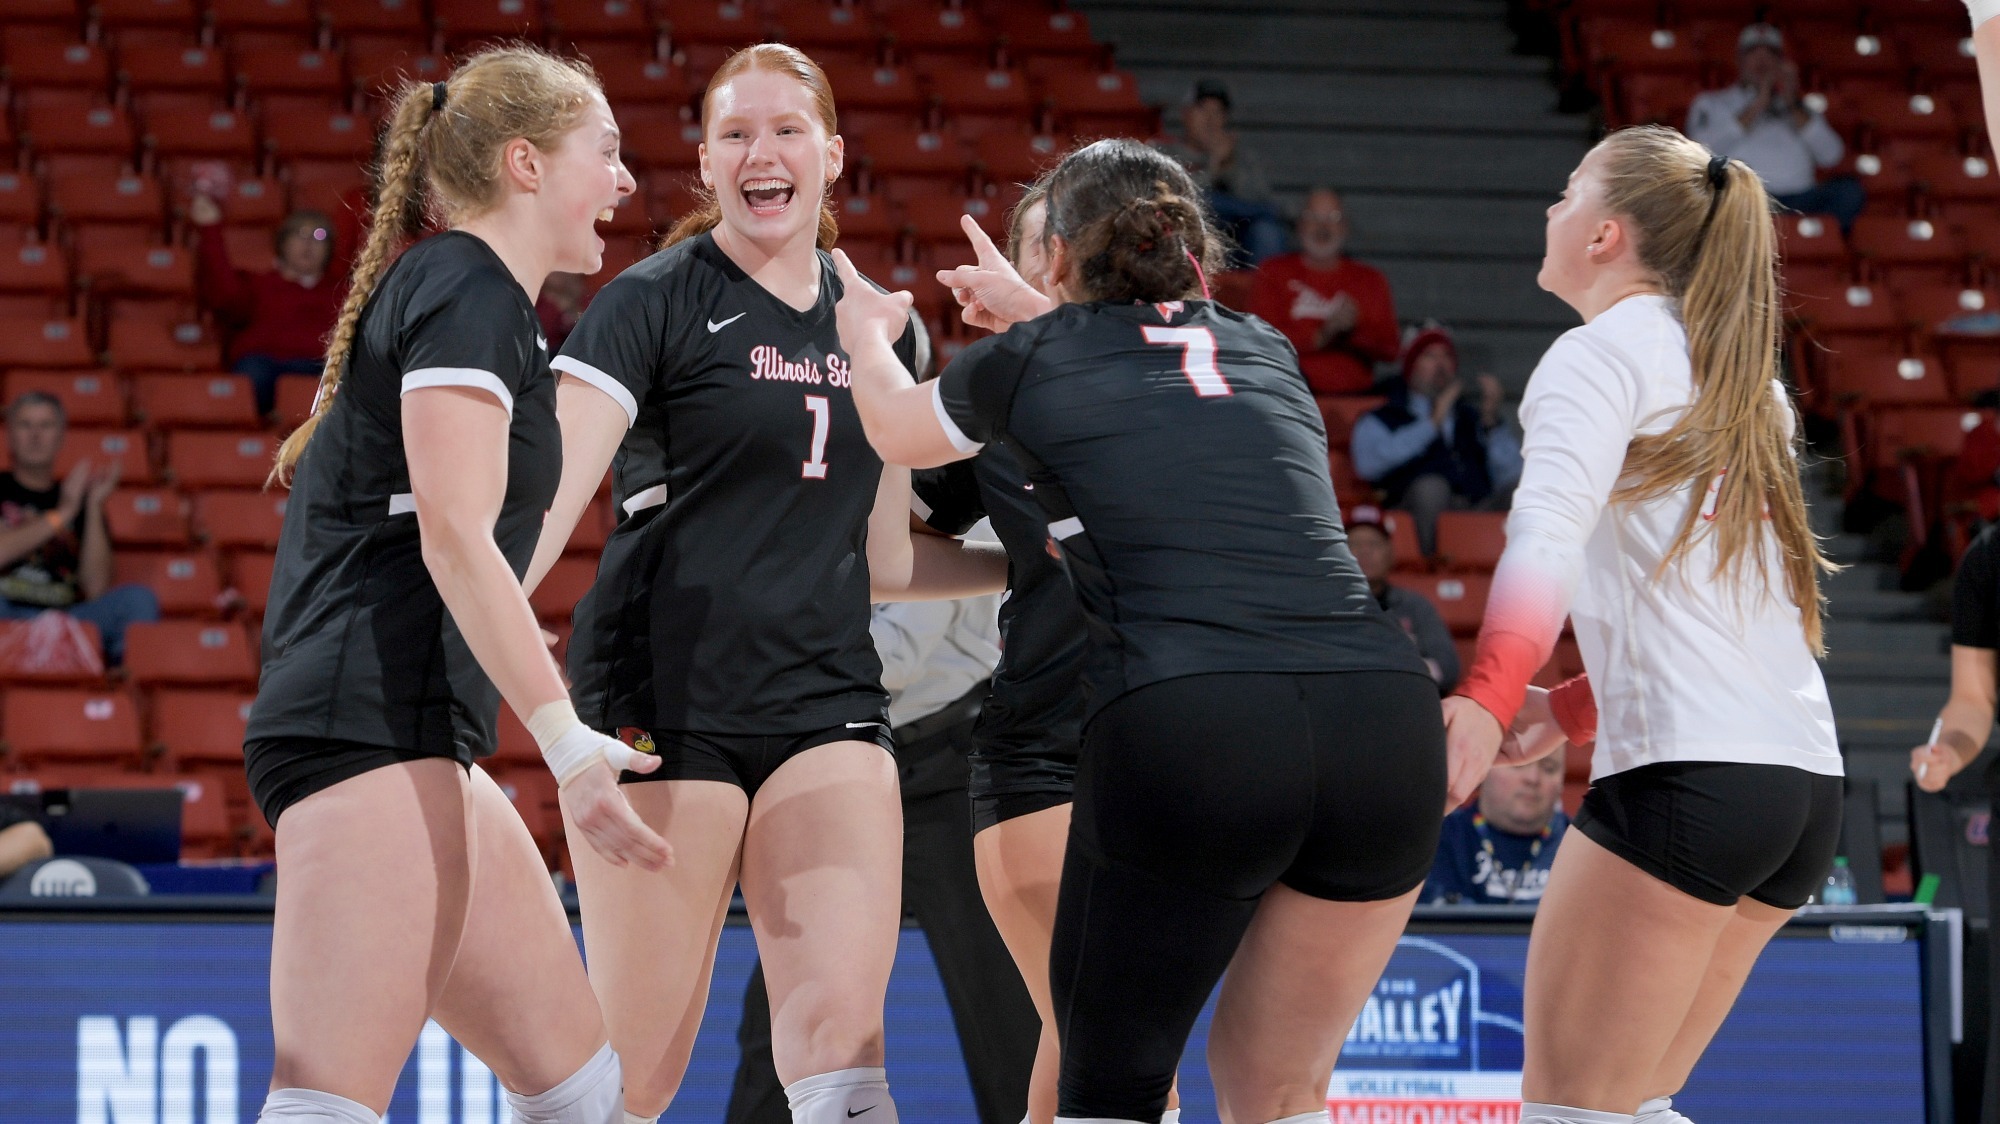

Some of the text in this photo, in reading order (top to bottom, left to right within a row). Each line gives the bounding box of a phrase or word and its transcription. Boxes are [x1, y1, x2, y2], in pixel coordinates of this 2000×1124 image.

[749, 344, 823, 386] Illinois
[1139, 324, 1235, 399] 7
[801, 393, 829, 480] 1
[76, 1014, 239, 1124] NO
